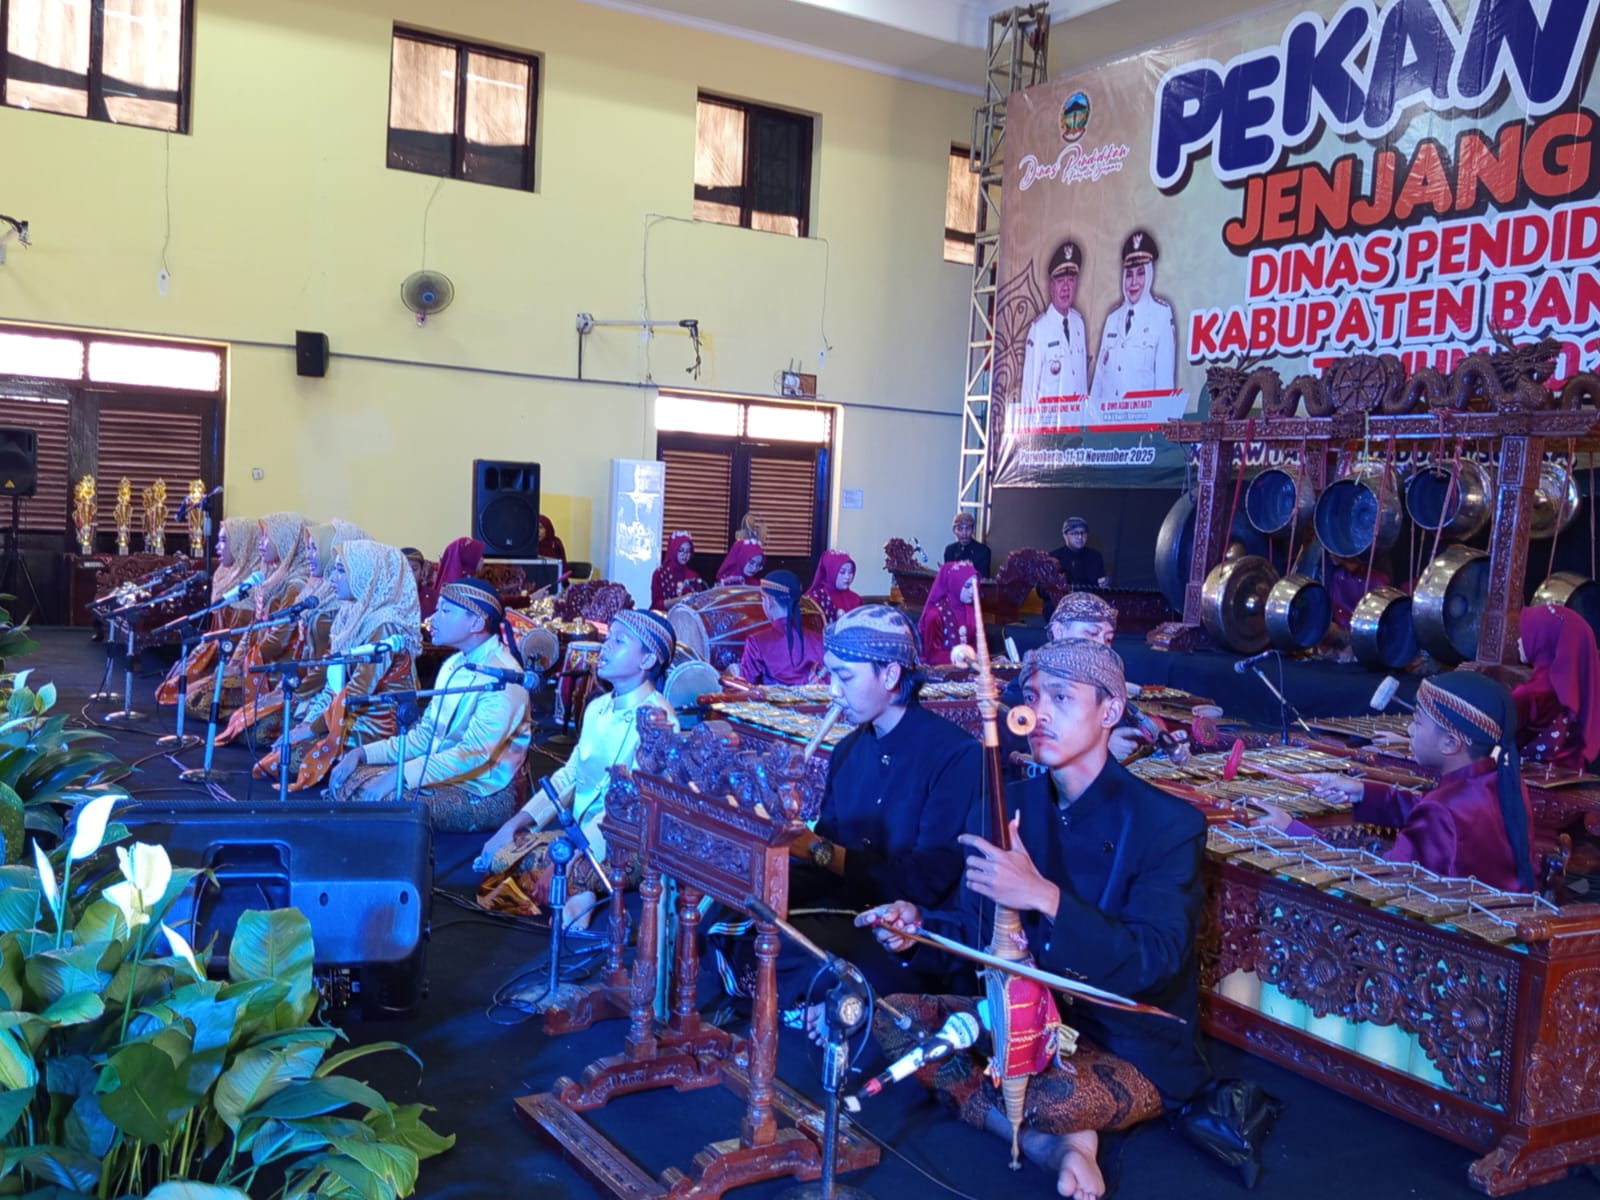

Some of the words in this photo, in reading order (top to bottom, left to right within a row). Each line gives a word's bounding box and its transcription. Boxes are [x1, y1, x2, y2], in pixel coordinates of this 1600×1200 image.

[1154, 0, 1589, 180] PEKAN
[1222, 113, 1593, 248] JENJANG
[1249, 235, 1392, 298] DINAS
[1405, 205, 1600, 279] PENDID
[1190, 284, 1475, 355] KABUPATEN
[1085, 448, 1129, 464] November
[1129, 447, 1155, 464] 2025
